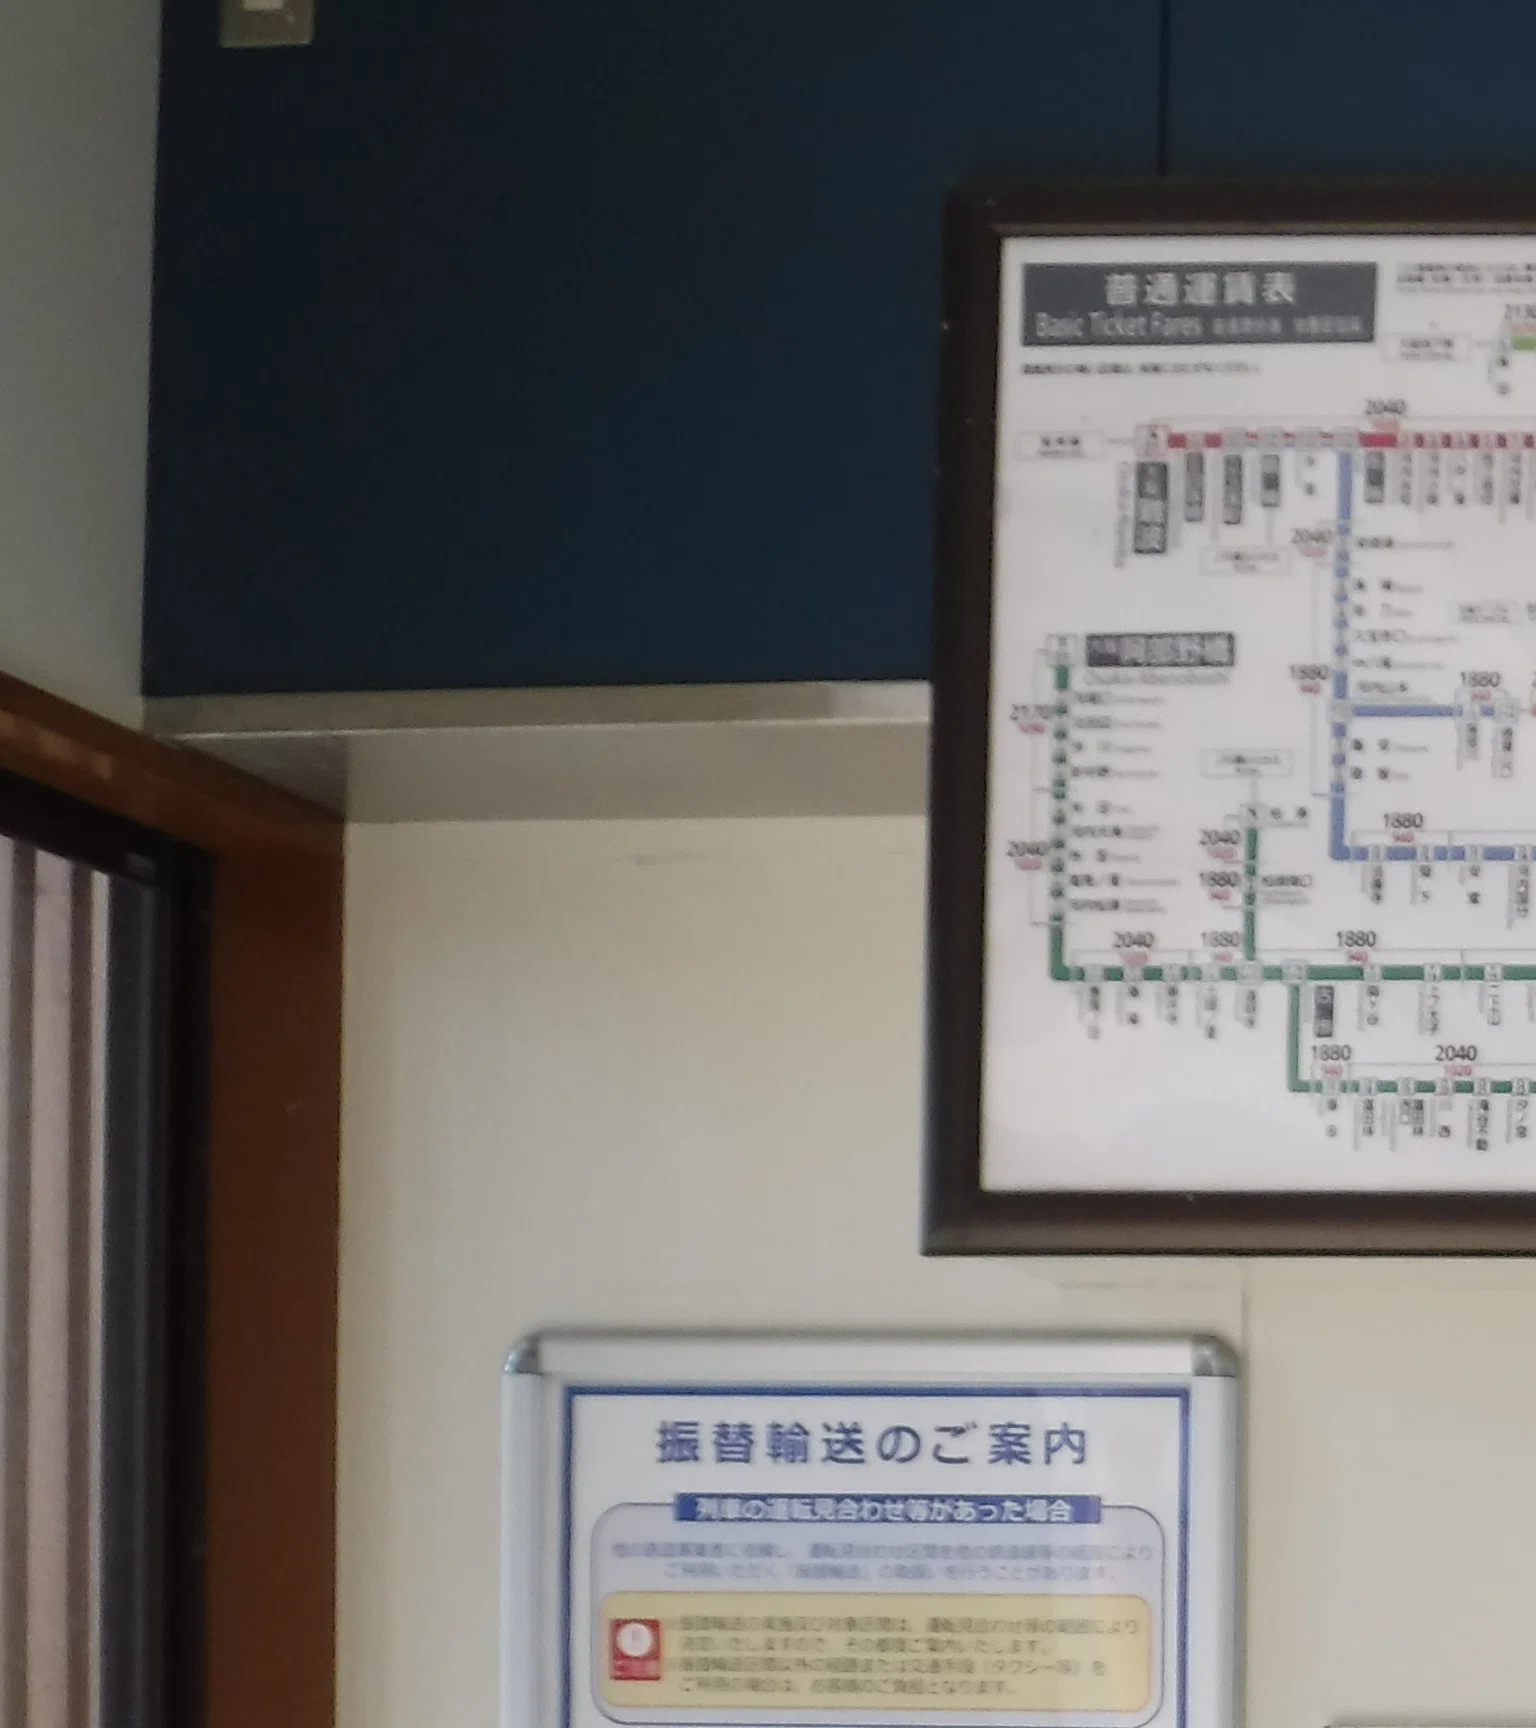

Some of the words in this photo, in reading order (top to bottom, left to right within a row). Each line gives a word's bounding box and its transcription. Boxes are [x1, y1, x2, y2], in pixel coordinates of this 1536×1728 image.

[656, 1420, 1088, 1465] 振替輸送のご案内
